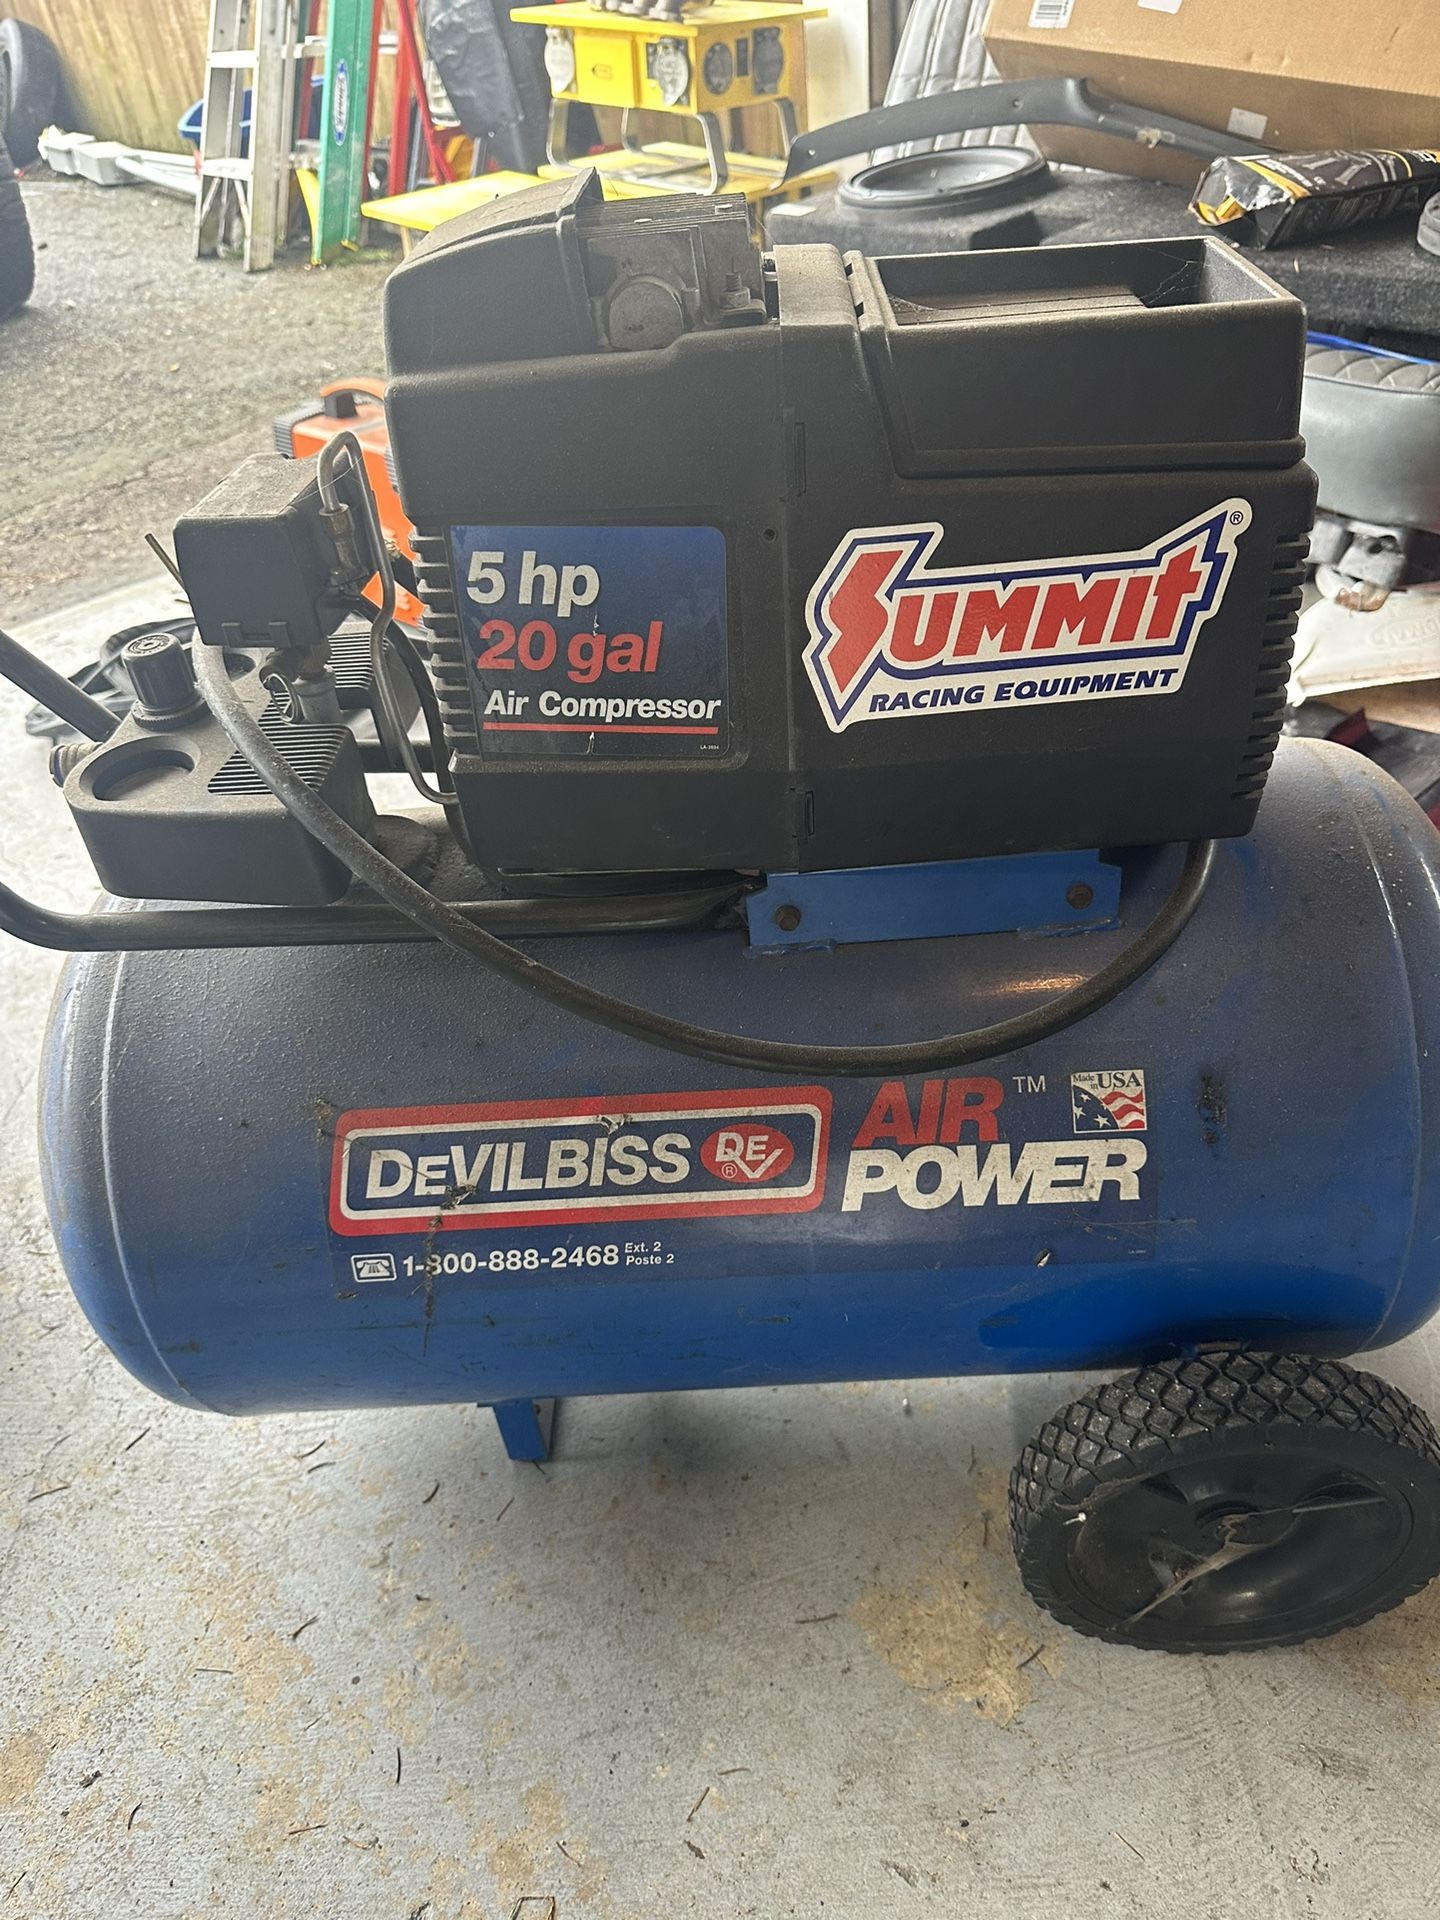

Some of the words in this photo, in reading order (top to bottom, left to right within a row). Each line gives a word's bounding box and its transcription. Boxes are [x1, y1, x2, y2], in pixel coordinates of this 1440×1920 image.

[466, 550, 506, 605] 5
[518, 551, 600, 618] hp
[476, 619, 557, 671] 20
[567, 620, 664, 684] gal
[484, 689, 529, 715] Air
[538, 690, 721, 723] Compressor
[868, 685, 984, 713] RACING
[994, 668, 1179, 702] EQUIPMENT
[1073, 1074, 1095, 1083] Made
[1097, 1071, 1142, 1089] USA
[852, 1076, 1005, 1148] AIR
[1012, 1075, 1046, 1094] TM
[841, 1138, 1148, 1212] POWER
[402, 1244, 620, 1277] 1-800-888-2468
[625, 1242, 648, 1254] Ext.
[653, 1241, 662, 1252] 2
[626, 1255, 662, 1266] Poste
[666, 1253, 675, 1264] 2
